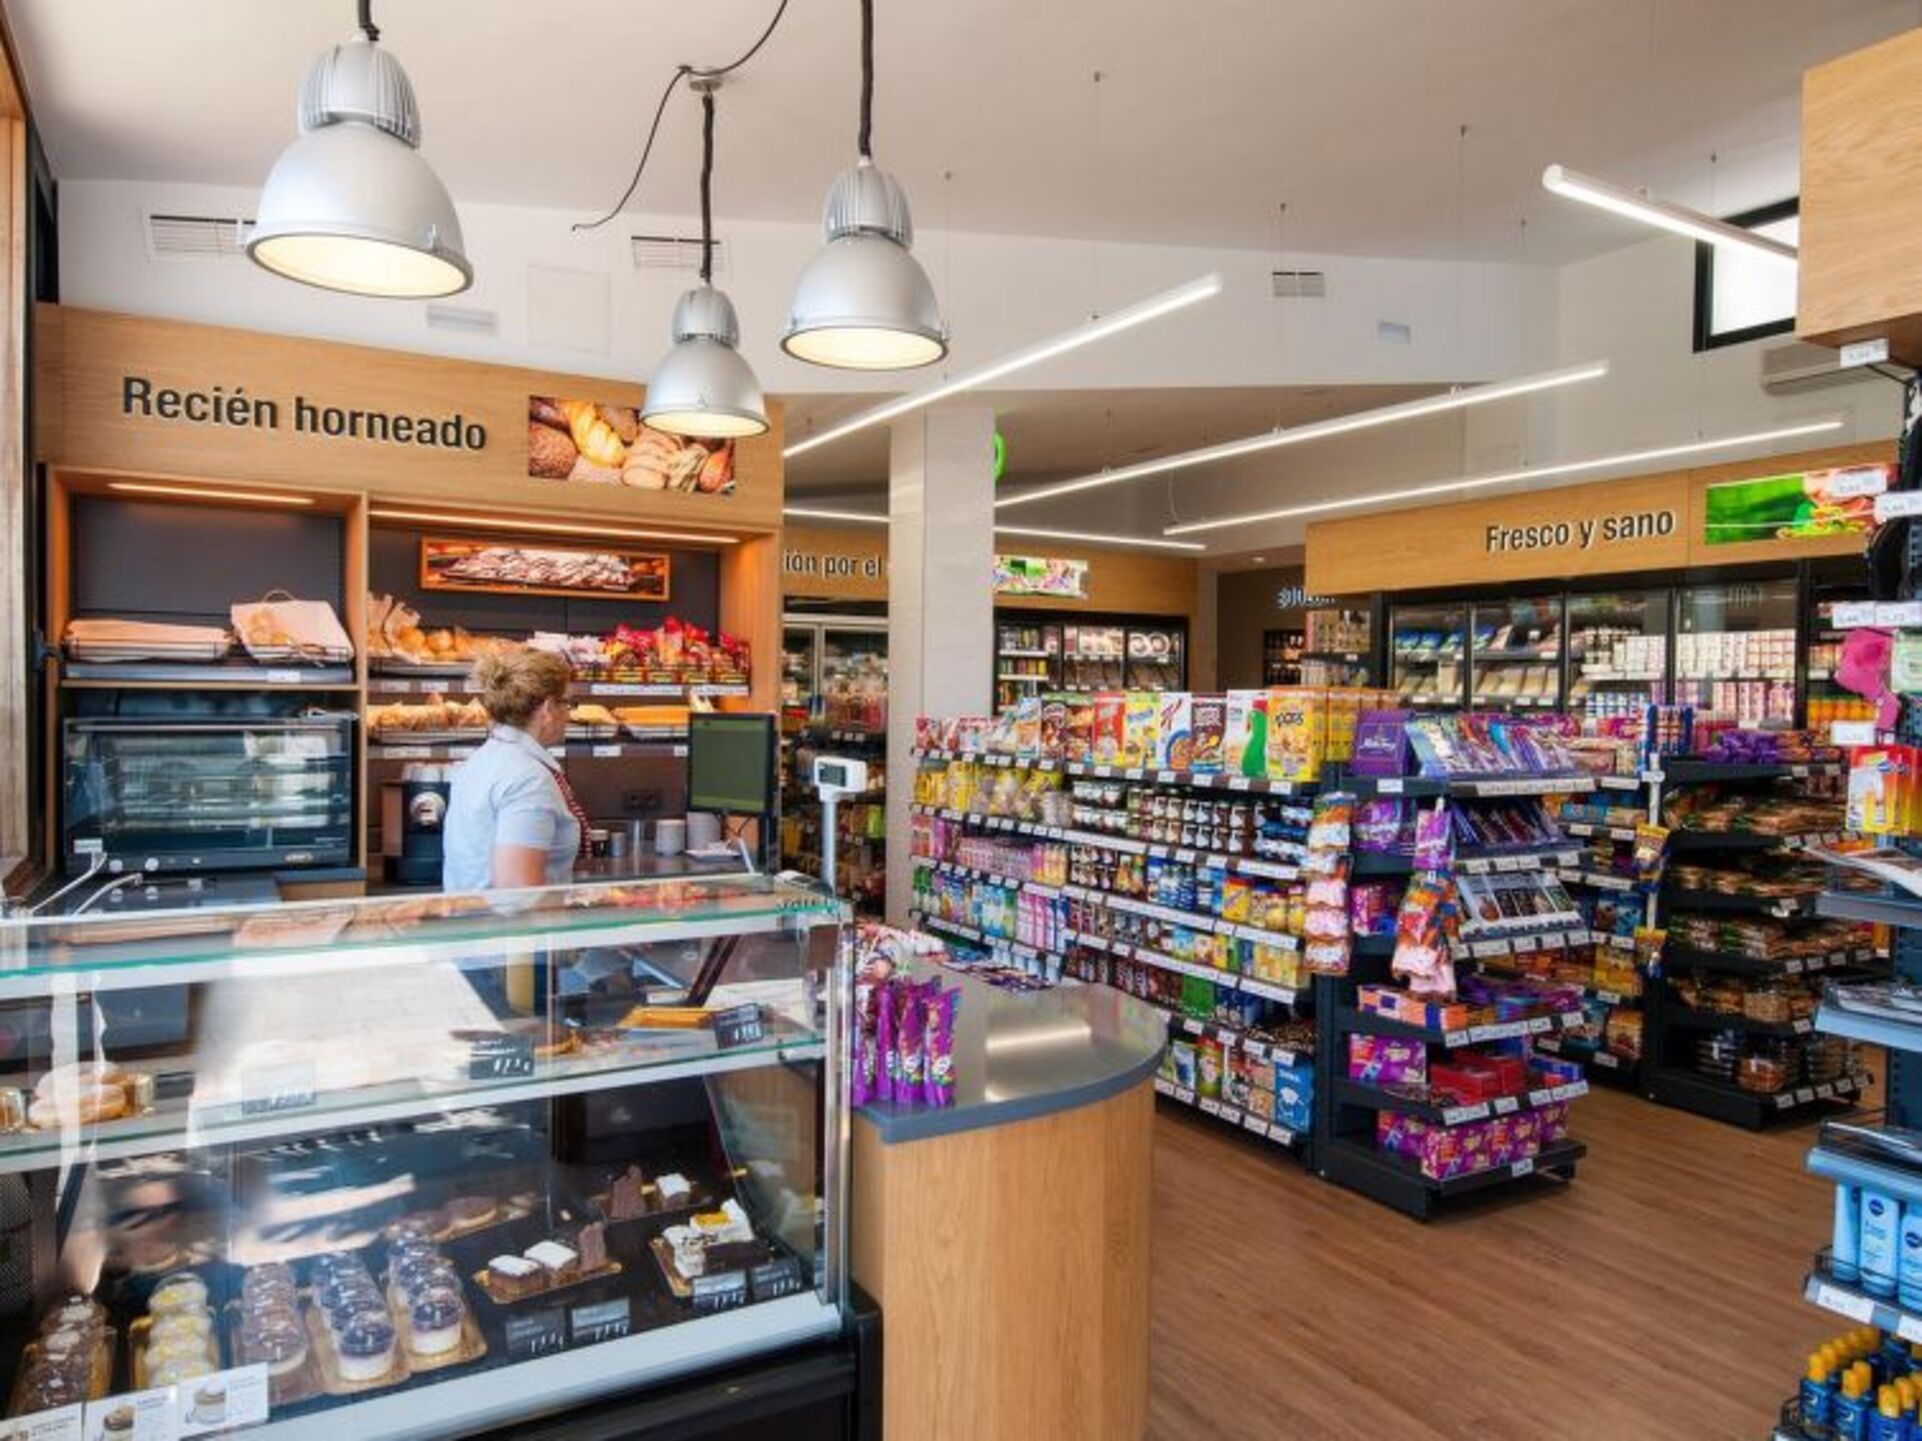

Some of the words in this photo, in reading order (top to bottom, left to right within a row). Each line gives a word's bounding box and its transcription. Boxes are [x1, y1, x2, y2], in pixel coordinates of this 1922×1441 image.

[122, 375, 279, 428] Recién
[294, 396, 488, 452] horneado
[1485, 522, 1571, 554] Fresco
[1580, 518, 1596, 549] y
[1602, 510, 1677, 541] sano
[785, 549, 818, 573] ión
[823, 553, 858, 579] por
[863, 554, 883, 578] el
